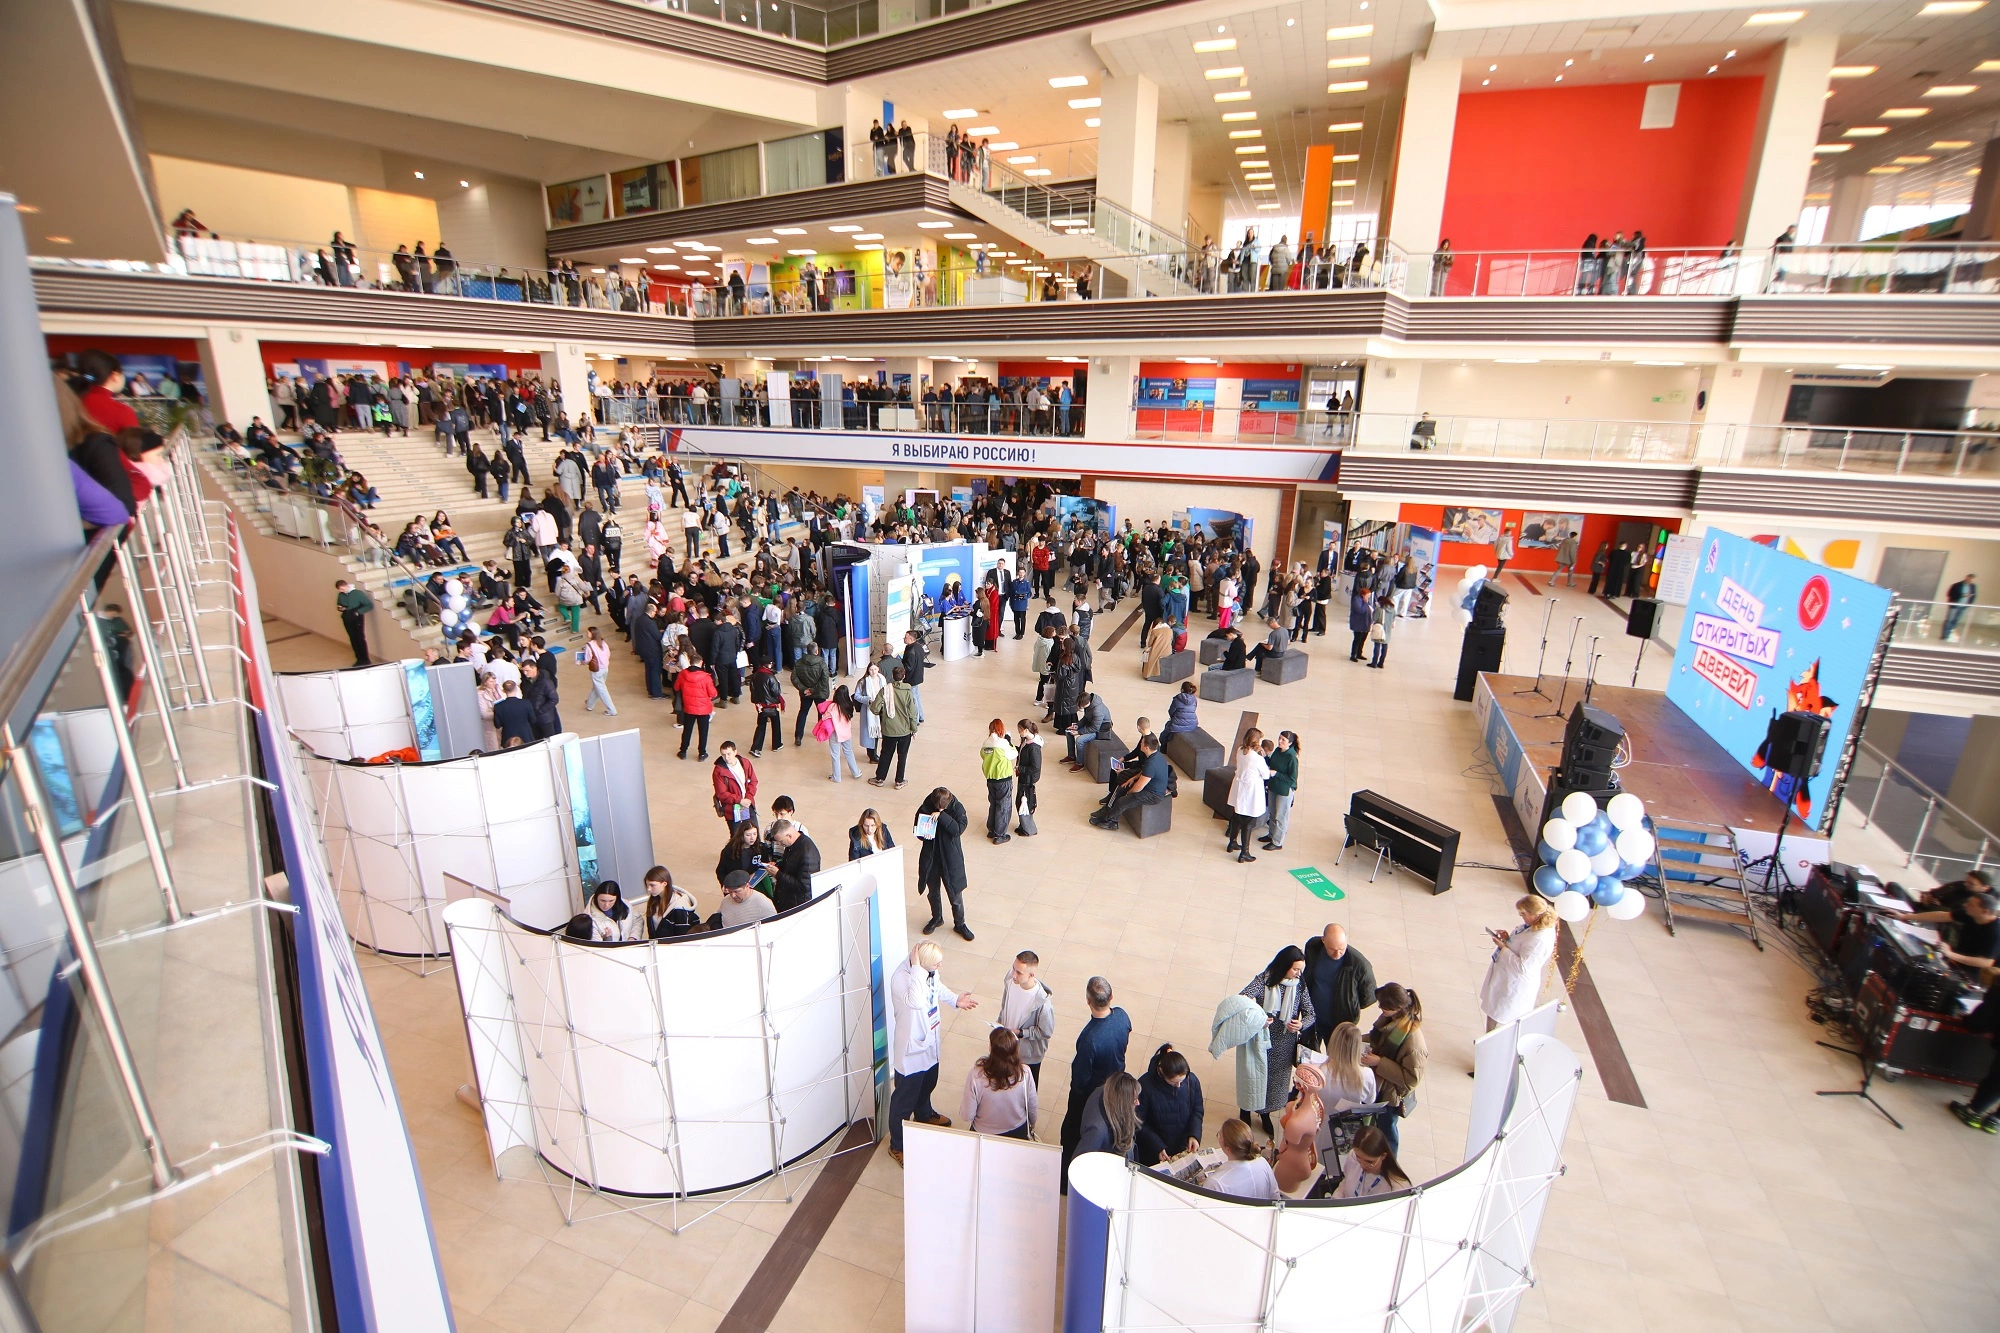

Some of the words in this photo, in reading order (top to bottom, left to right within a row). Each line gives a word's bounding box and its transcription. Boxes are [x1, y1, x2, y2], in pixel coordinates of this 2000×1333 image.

[892, 443, 899, 456] Я
[904, 443, 969, 459] ВЫБИРАЮ
[973, 446, 1036, 463] РОССИЮ!
[1722, 586, 1756, 623] ДЕНЬ
[1695, 621, 1771, 659] ОТКРЫТЫХ
[1696, 649, 1749, 698] ДВЕРЕЙ
